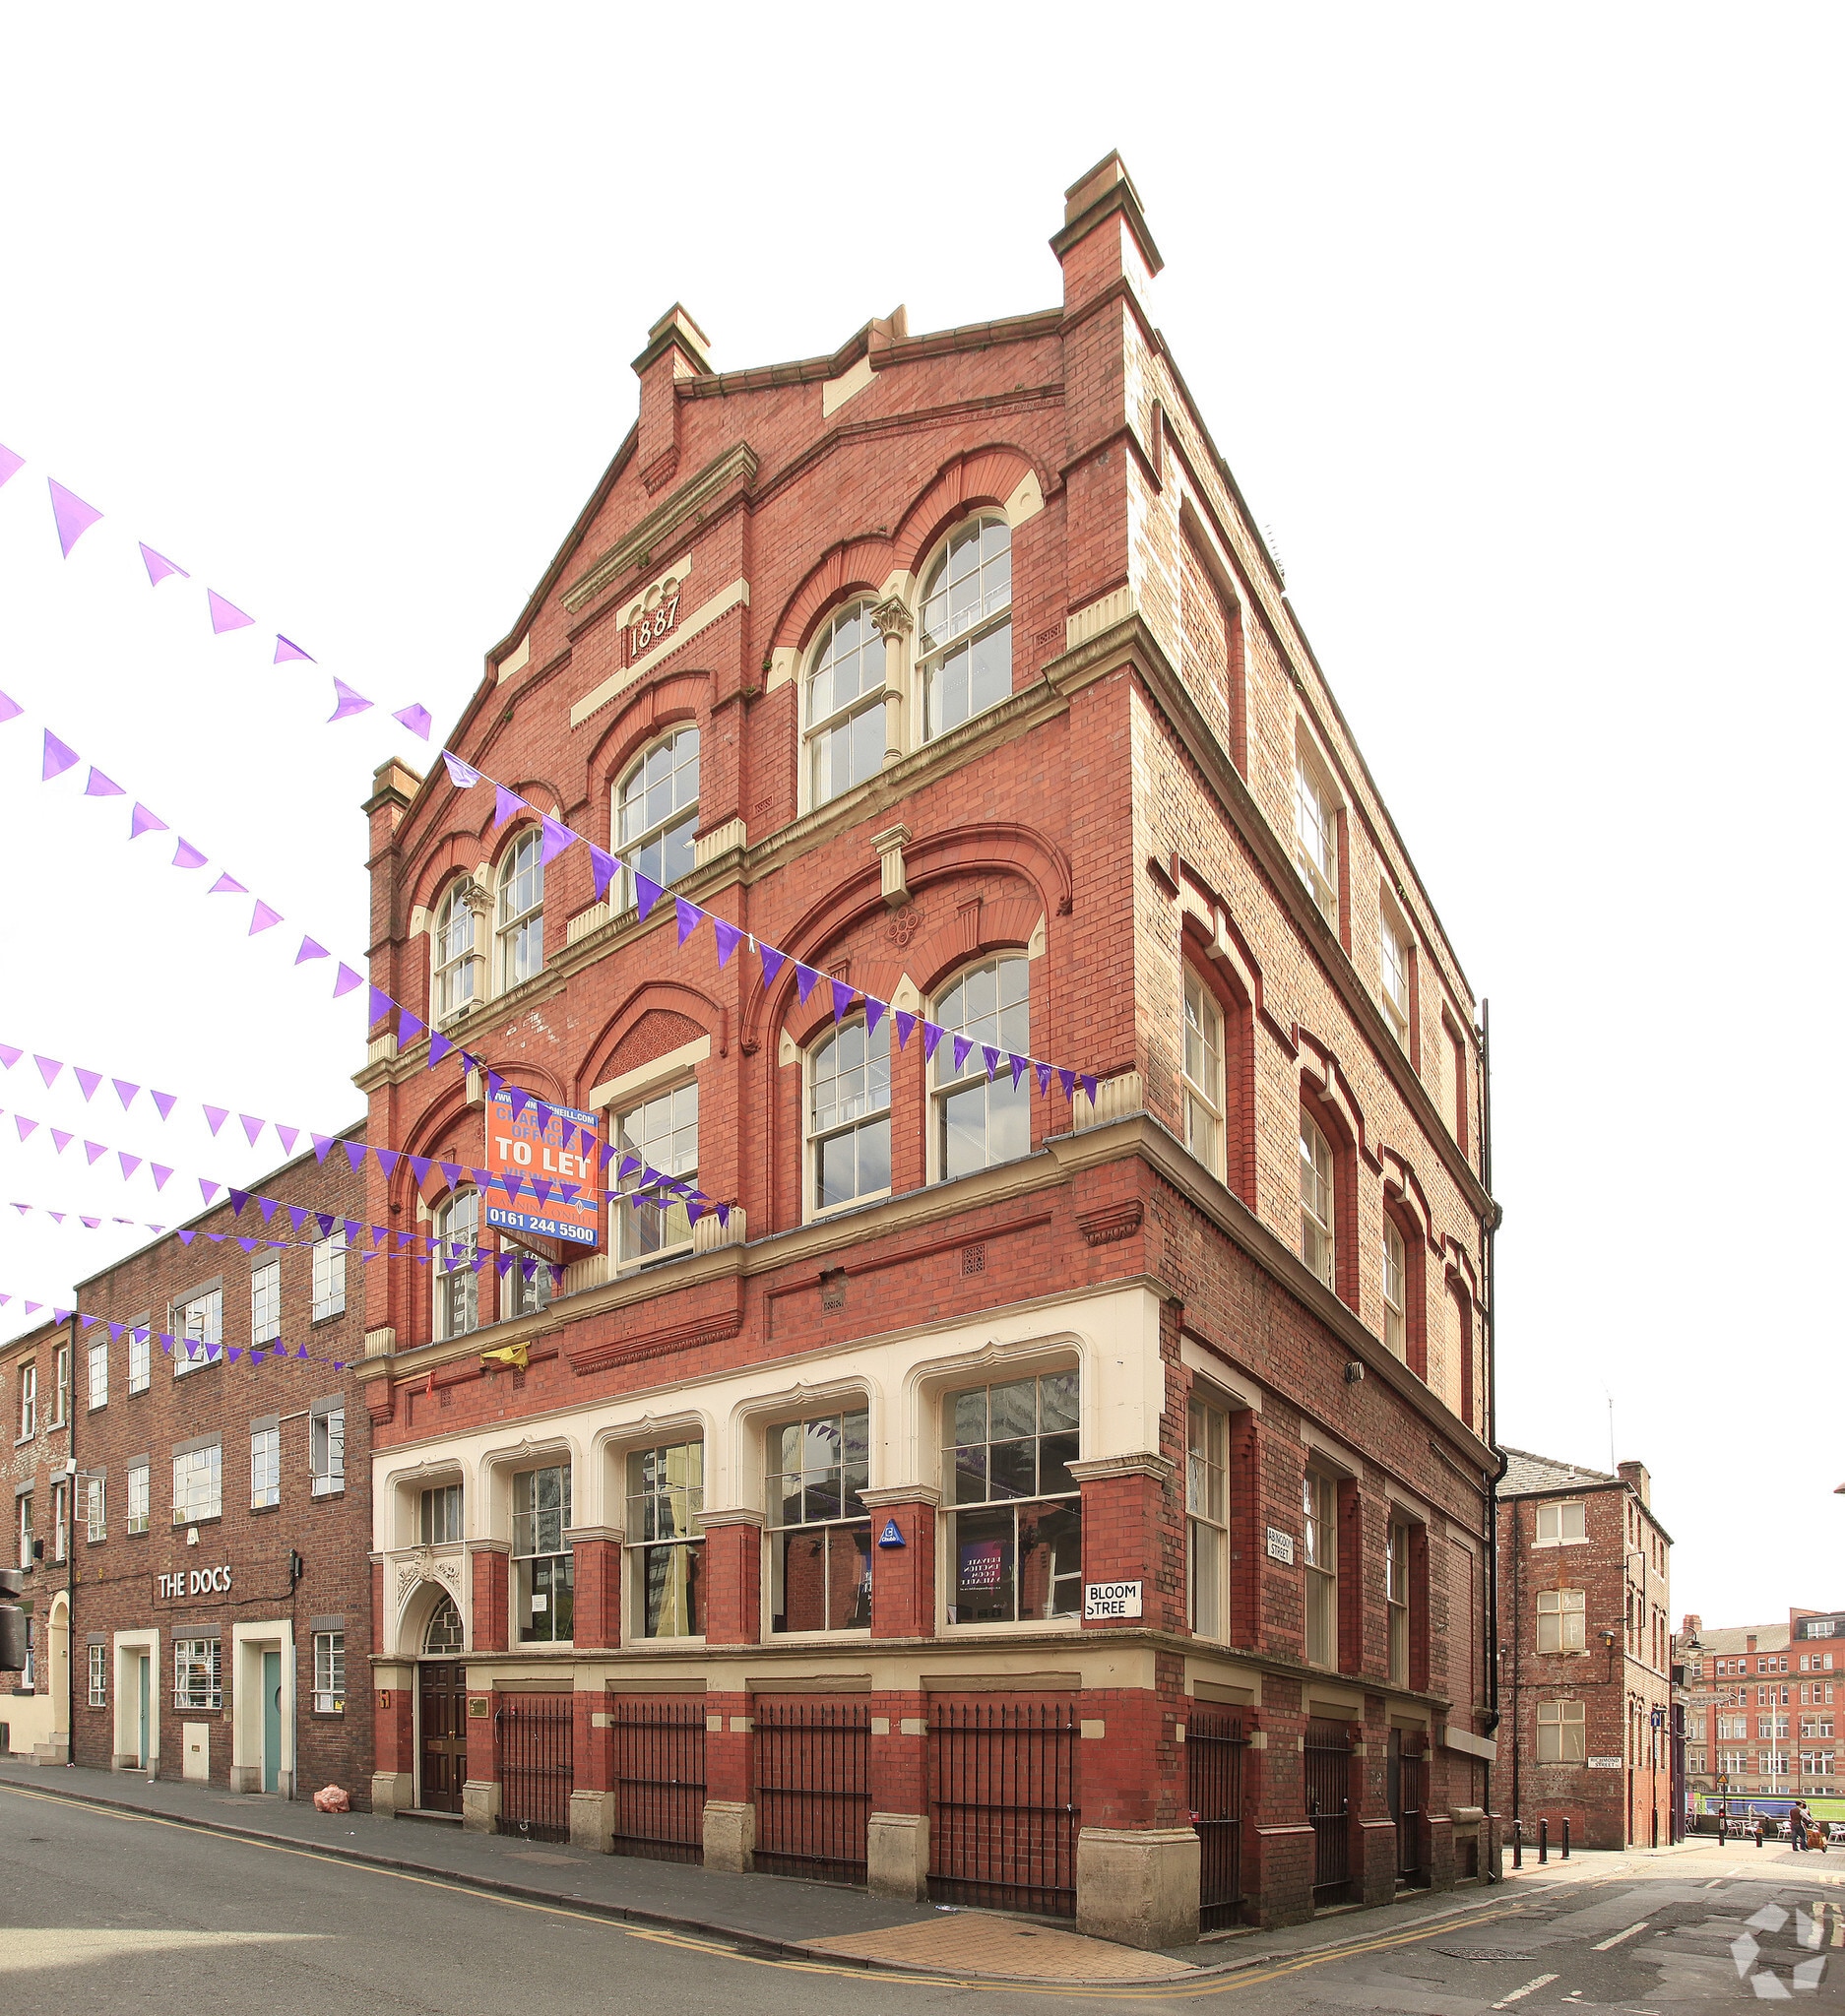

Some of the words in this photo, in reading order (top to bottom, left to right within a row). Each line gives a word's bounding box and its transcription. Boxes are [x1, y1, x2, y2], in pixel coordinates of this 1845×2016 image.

[631, 595, 680, 658] 1887
[494, 1136, 533, 1166] TO
[542, 1148, 592, 1179] LET
[489, 1209, 524, 1227] 0161
[530, 1217, 556, 1233] 244
[559, 1223, 594, 1242] 5500
[1271, 1544, 1289, 1560] STREET
[158, 1572, 185, 1599] THE
[190, 1565, 232, 1595] DOCS
[1090, 1585, 1136, 1600] BLOOM
